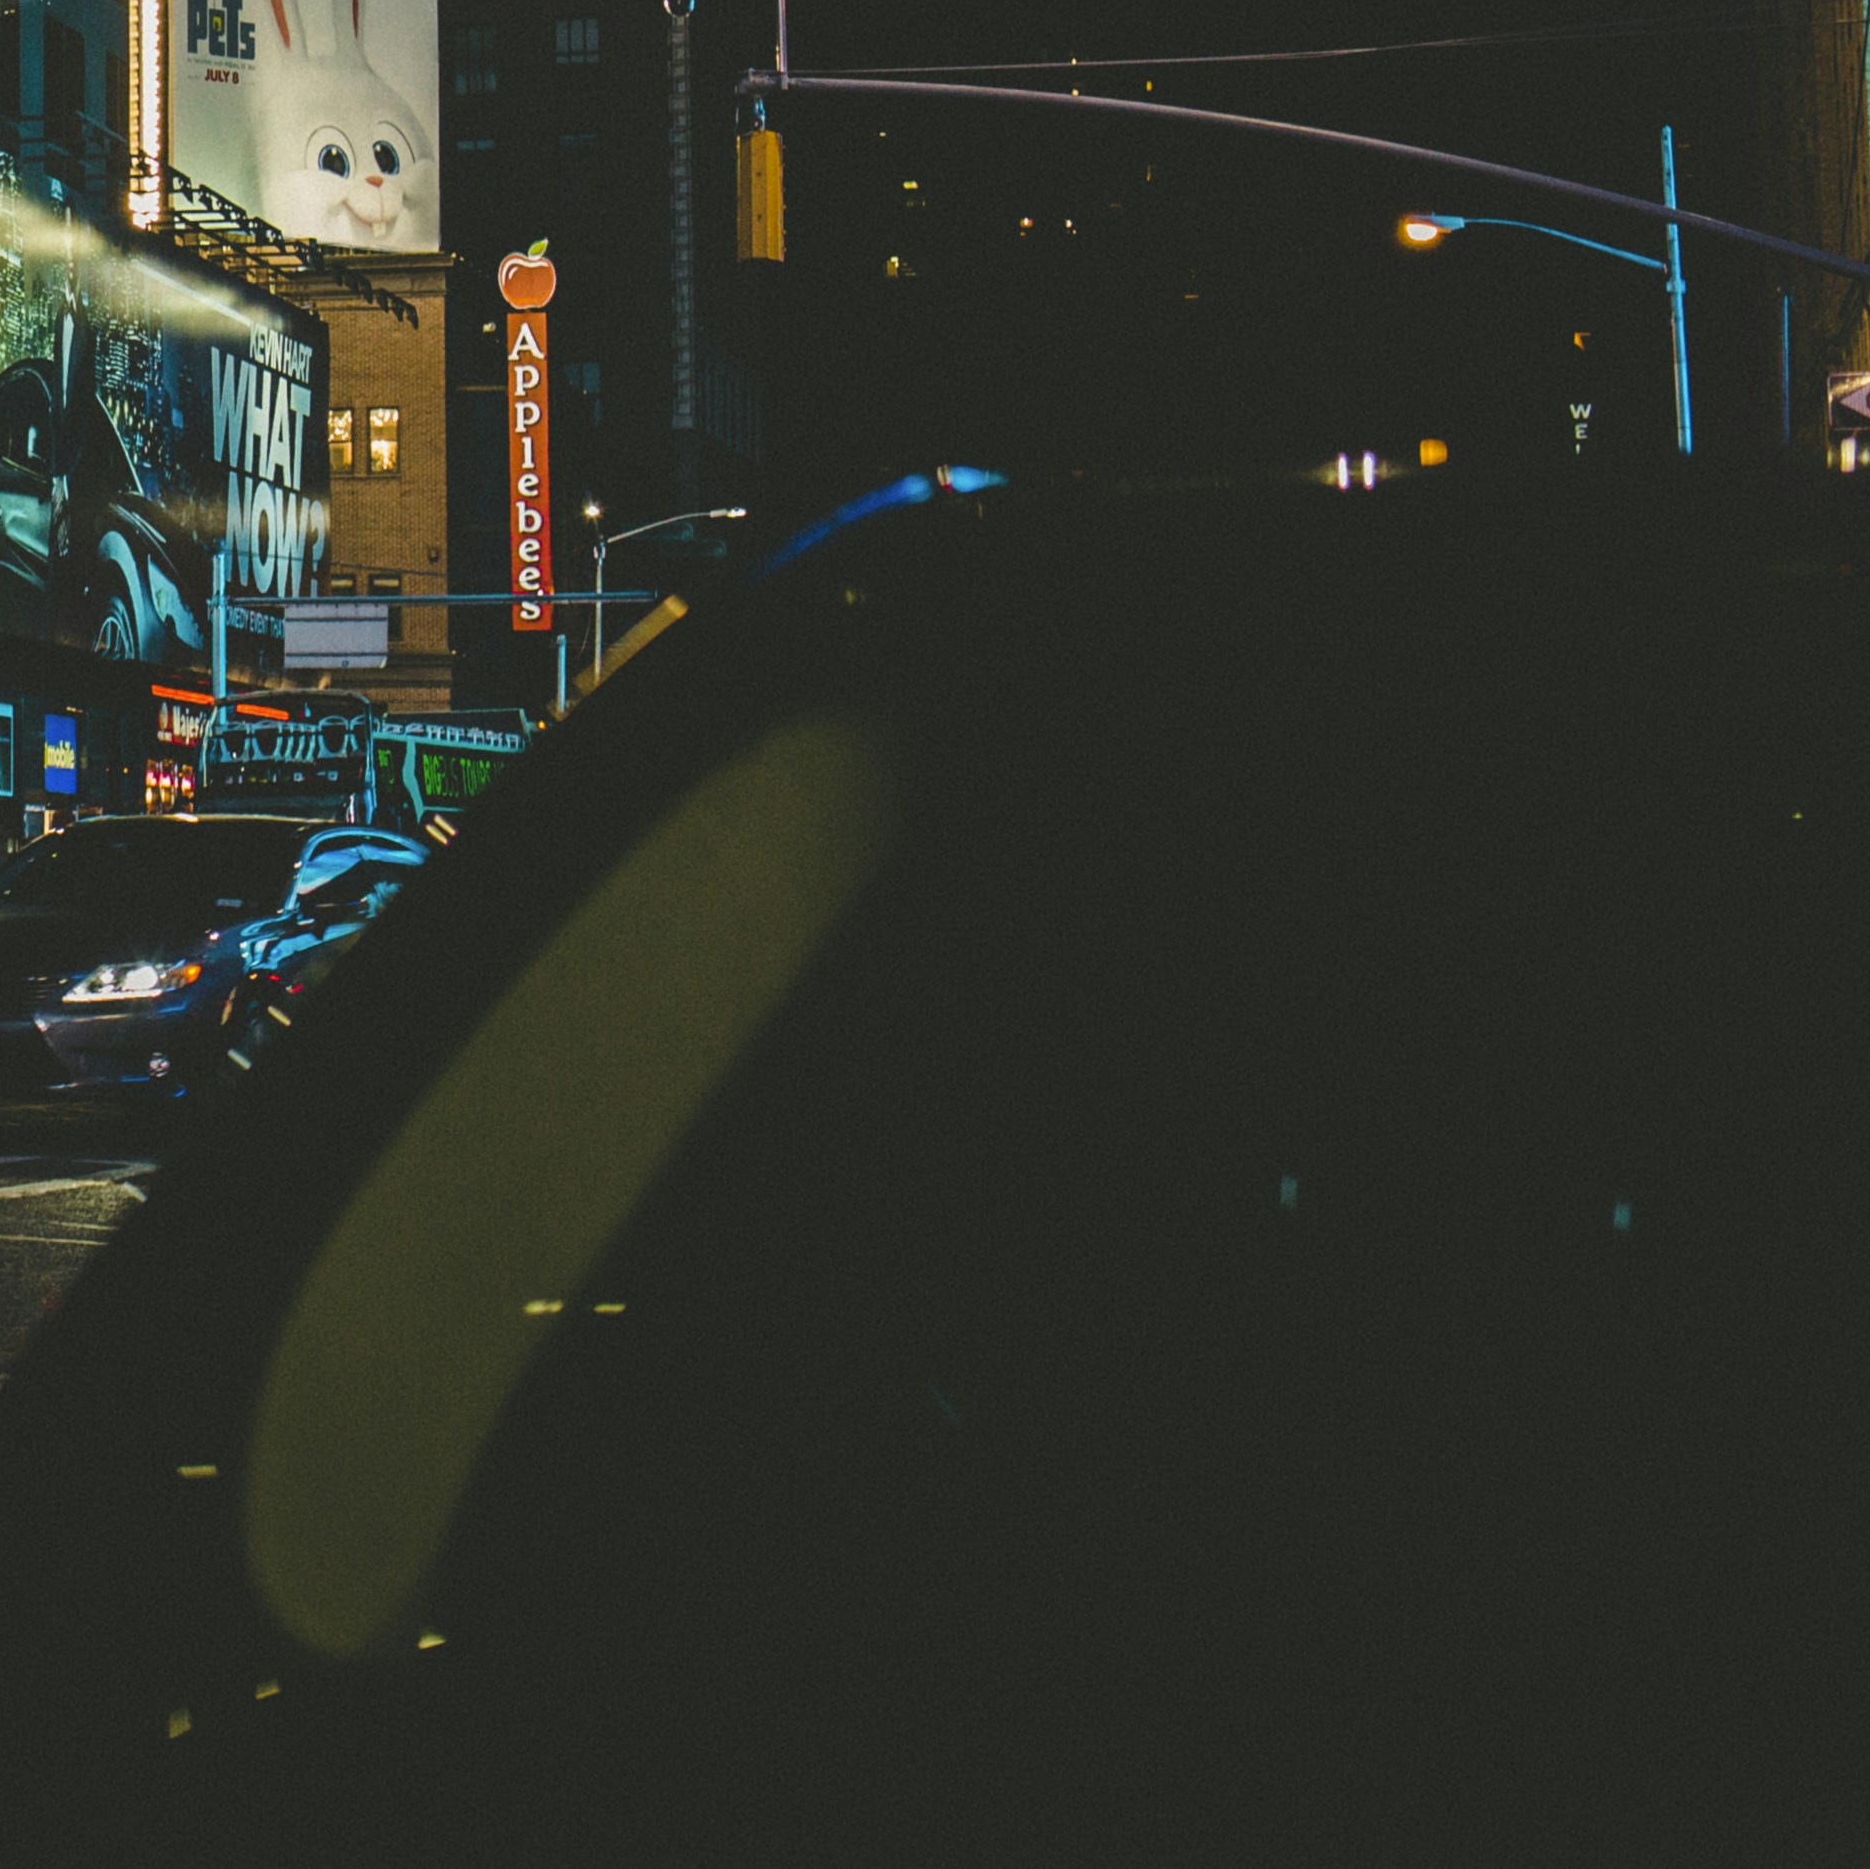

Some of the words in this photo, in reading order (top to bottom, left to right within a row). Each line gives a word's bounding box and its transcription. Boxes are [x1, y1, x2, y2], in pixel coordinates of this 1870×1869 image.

[205, 68, 231, 83] JULY
[232, 71, 240, 85] 8
[248, 319, 281, 367] KEVIN
[281, 335, 313, 383] HART
[210, 346, 313, 491] WHAT
[506, 321, 548, 623] Applebee's
[225, 469, 328, 600] NOW?
